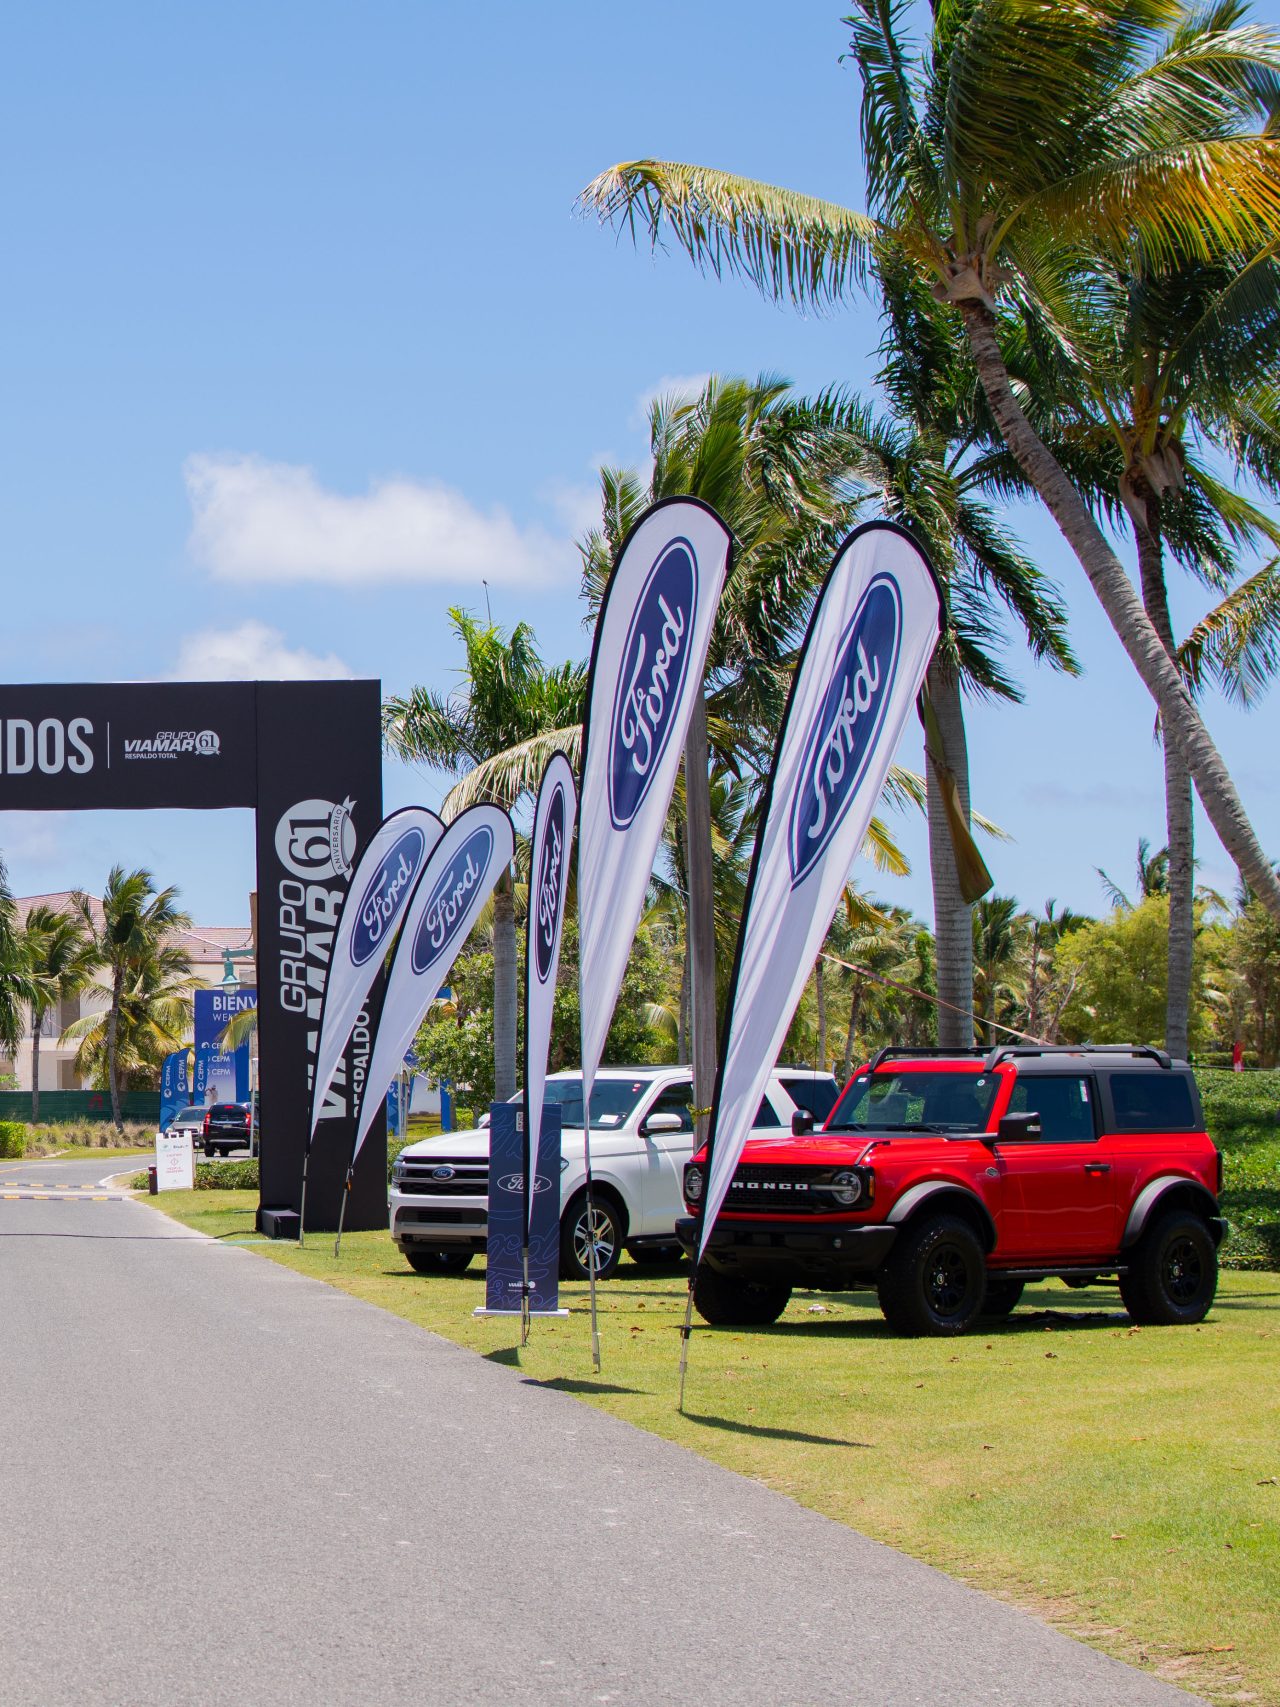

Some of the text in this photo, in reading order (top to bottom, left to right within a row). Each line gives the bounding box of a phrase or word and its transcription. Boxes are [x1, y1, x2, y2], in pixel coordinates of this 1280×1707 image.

[621, 594, 684, 776] Ford
[124, 739, 194, 752] VIAMAR
[156, 731, 196, 740] GRUPO
[199, 734, 216, 748] 61
[288, 811, 332, 868] 61
[332, 808, 344, 870] ANIVERSARIO
[362, 852, 412, 942] Ford
[426, 852, 480, 949] Ford
[540, 819, 562, 948] Ford
[278, 879, 307, 1013] GRUPO
[507, 1175, 542, 1191] Fod
[731, 1181, 809, 1191] RONCO
